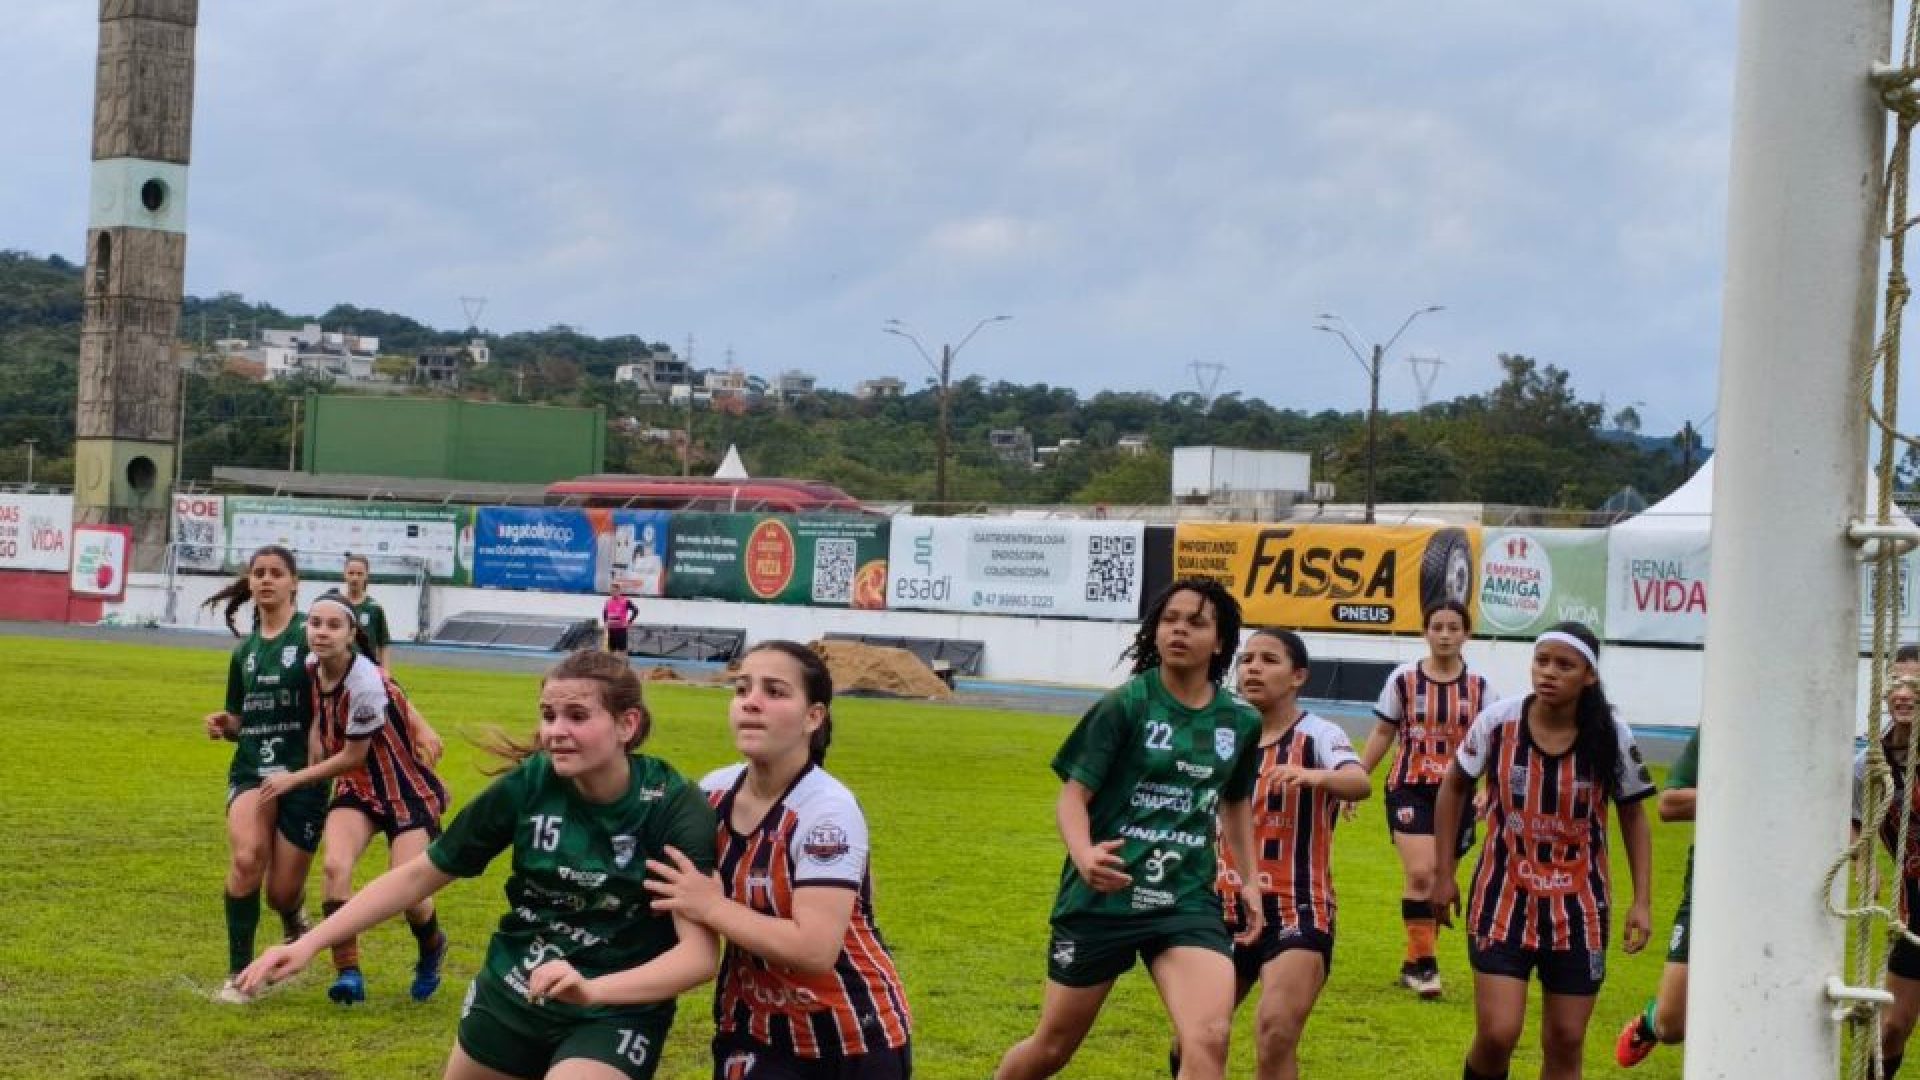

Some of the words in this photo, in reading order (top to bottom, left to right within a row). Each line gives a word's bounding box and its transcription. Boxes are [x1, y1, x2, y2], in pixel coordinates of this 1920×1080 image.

[176, 501, 218, 517] DOE
[31, 529, 64, 551] VIDA
[1244, 529, 1396, 599] FASSA
[1486, 562, 1541, 580] EMPRESA
[1631, 559, 1687, 580] RENAL
[896, 576, 952, 601] esadi
[1483, 577, 1541, 597] AMIGA
[1632, 578, 1708, 615] VIDA
[1338, 605, 1390, 621] PNEUS
[1557, 604, 1599, 624] VIDA
[1145, 720, 1174, 750] 22
[530, 814, 563, 852] 15
[616, 1029, 650, 1066] 15
